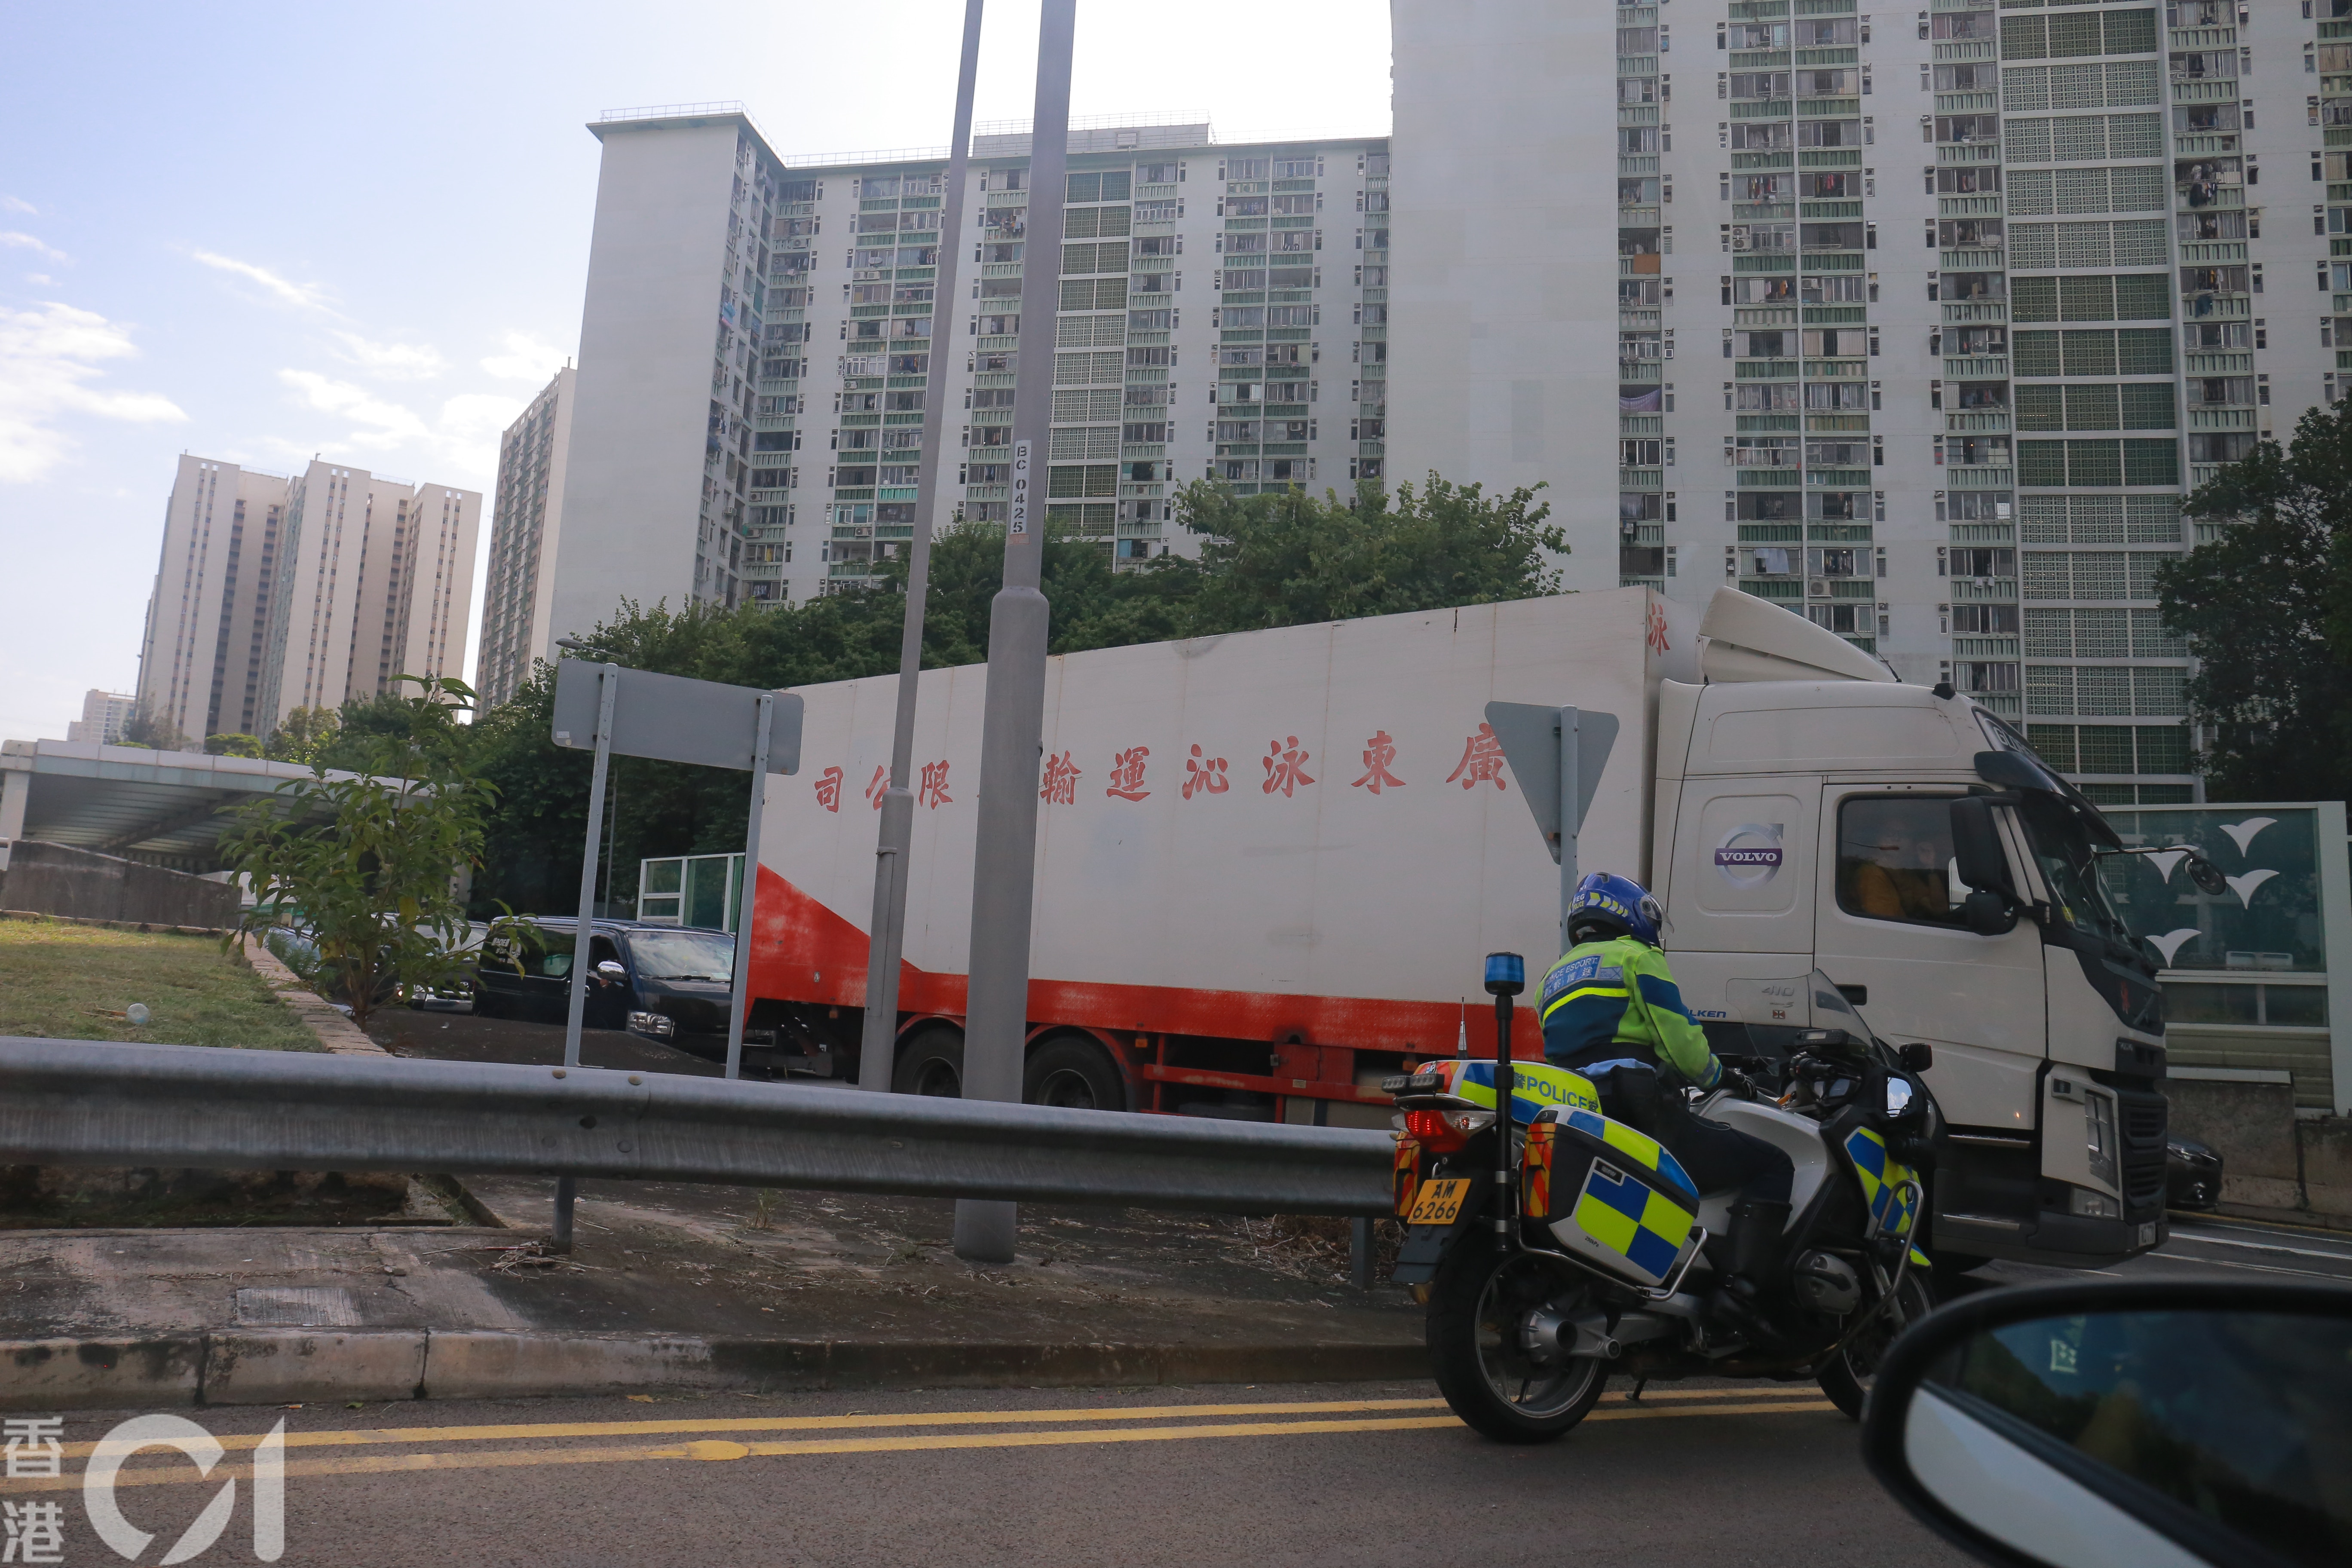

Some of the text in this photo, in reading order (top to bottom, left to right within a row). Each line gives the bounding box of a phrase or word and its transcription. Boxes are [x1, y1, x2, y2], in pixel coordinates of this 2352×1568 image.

[1017, 446, 1027, 470] BC
[1013, 479, 1026, 533] 0425
[1648, 602, 1670, 657] 泳
[814, 723, 1506, 814] 廣東泳沁運輸限公司
[1720, 853, 1777, 861] VOLVO
[1565, 958, 1598, 973] ESCORT
[1688, 1009, 1726, 1018] LKEN
[1527, 1076, 1587, 1109] POLICE
[1431, 1180, 1458, 1199] AM
[1412, 1201, 1457, 1219] 6266
